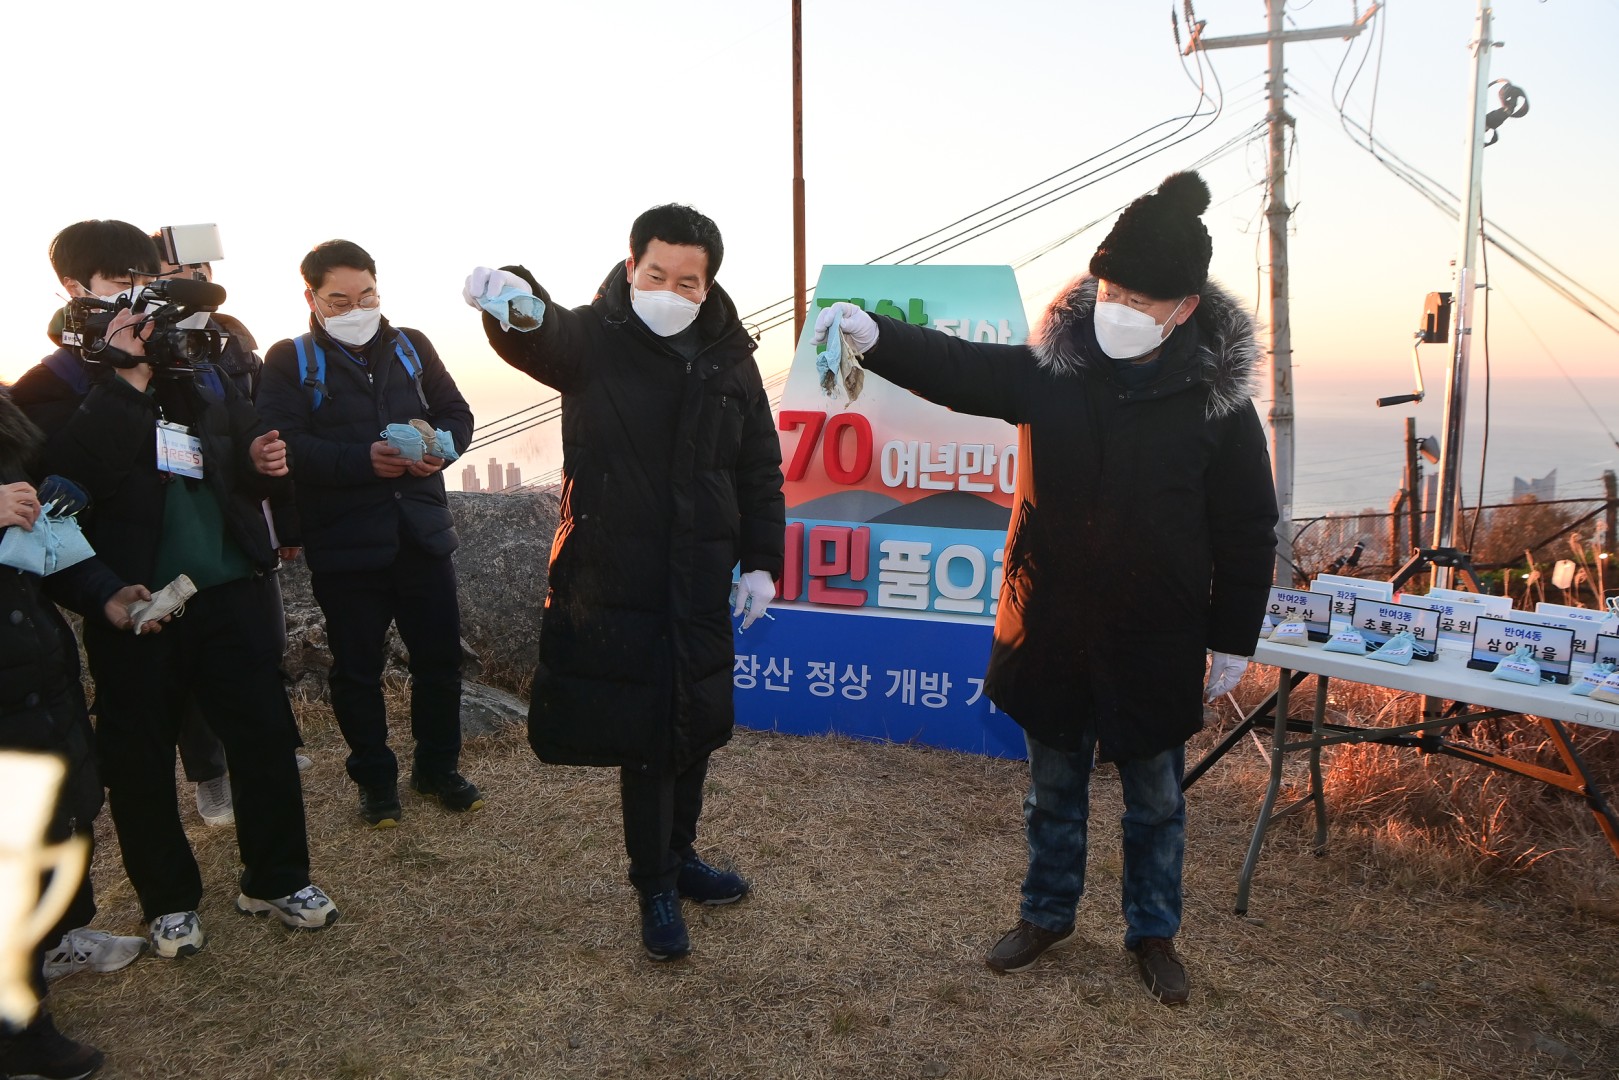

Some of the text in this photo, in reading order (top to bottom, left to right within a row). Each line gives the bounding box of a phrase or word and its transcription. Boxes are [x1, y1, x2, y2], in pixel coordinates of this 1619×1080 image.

[161, 446, 200, 465] PRESS
[778, 411, 874, 485] 70
[1277, 592, 1309, 606] 반여2동
[1379, 607, 1413, 622] 반여3동
[1504, 626, 1543, 642] 반여4동
[733, 654, 794, 692] 장산
[805, 661, 872, 700] 정상
[885, 668, 953, 709] 개방
